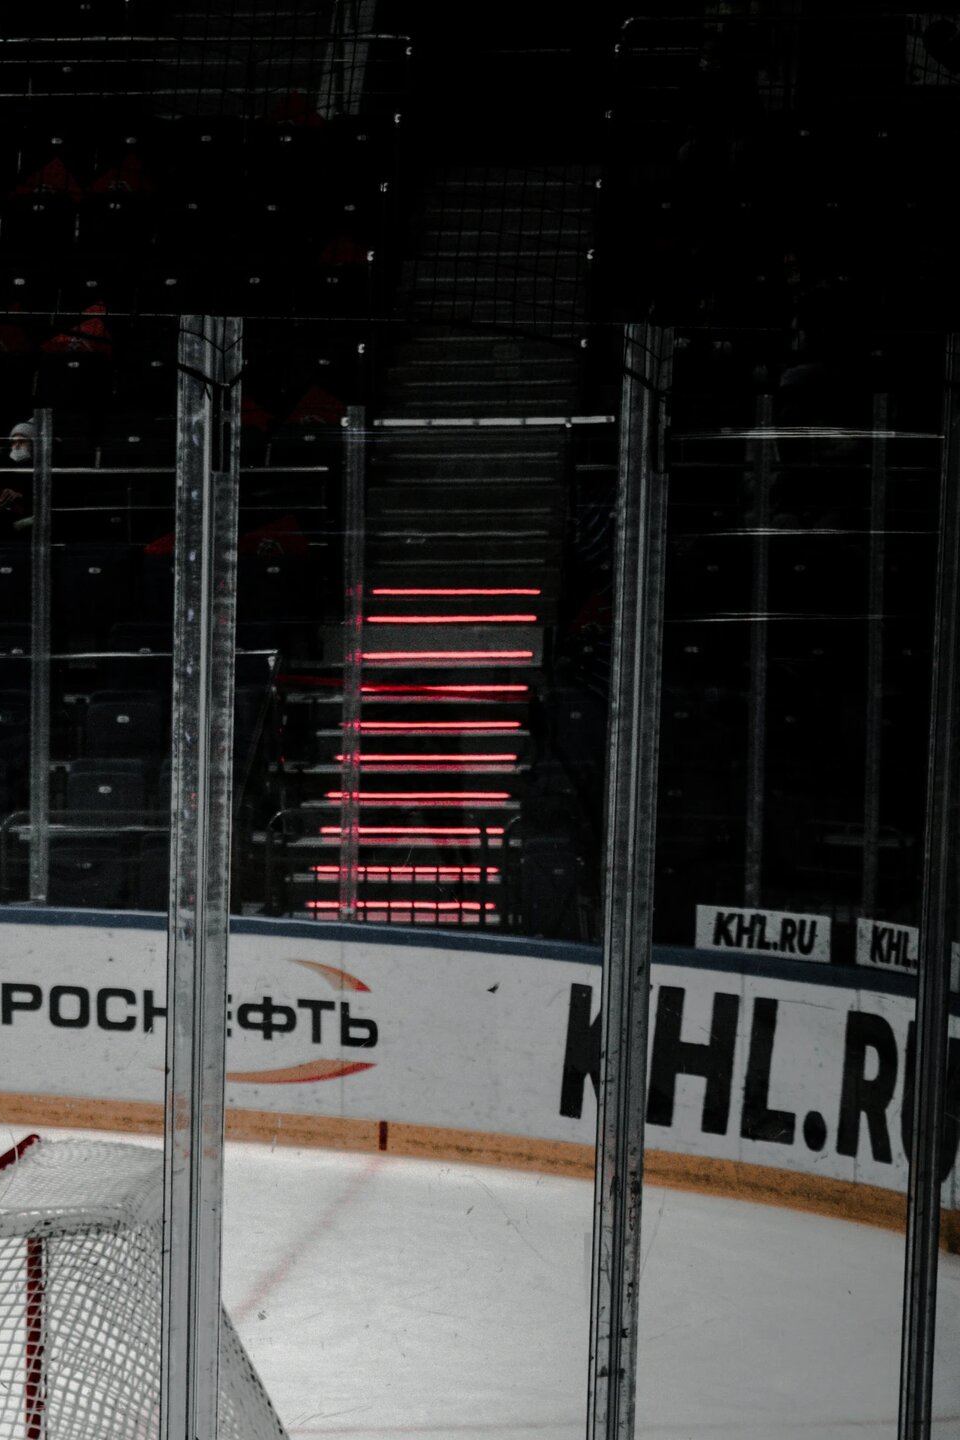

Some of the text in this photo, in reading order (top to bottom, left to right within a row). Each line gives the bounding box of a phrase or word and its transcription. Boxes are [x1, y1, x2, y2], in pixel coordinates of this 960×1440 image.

[713, 911, 817, 955] KHL.RU
[870, 924, 918, 967] KHL.
[1, 982, 379, 1049] РОСНФТЬ
